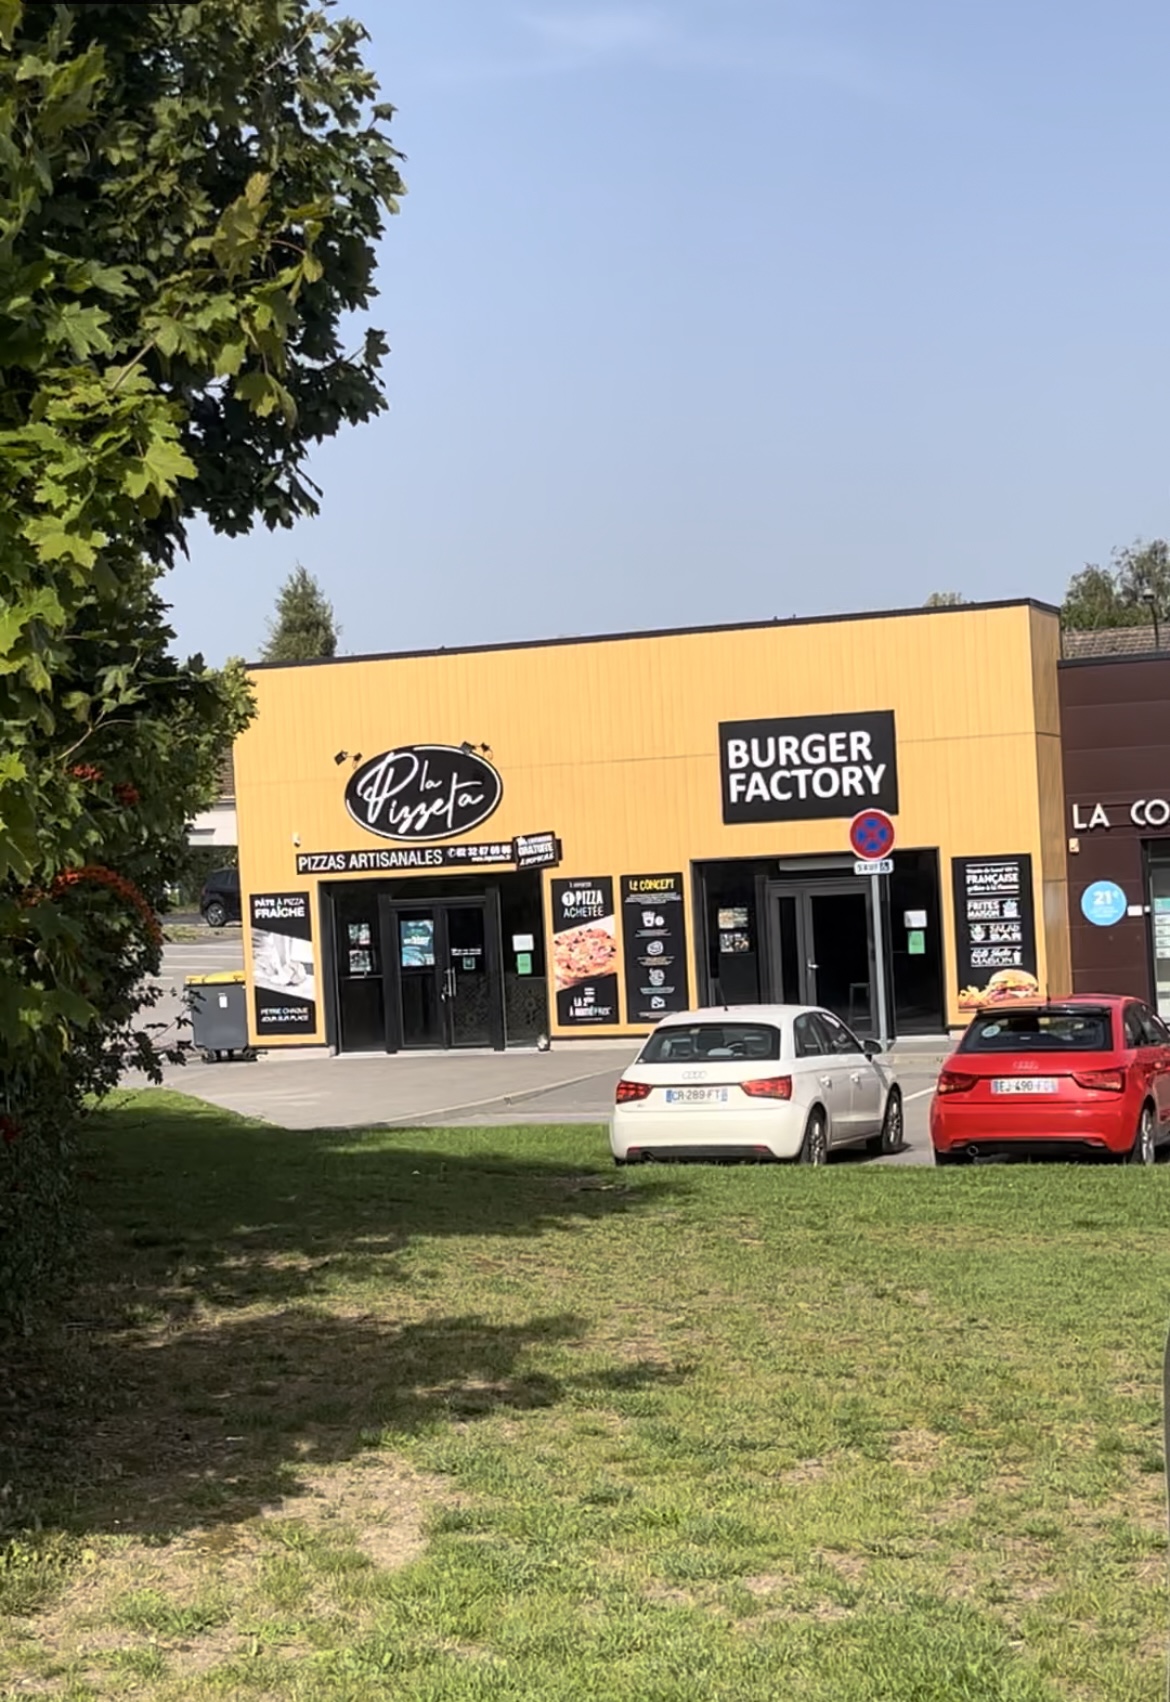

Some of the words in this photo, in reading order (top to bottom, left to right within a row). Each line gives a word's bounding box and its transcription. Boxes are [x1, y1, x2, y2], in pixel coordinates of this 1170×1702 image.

[727, 731, 872, 769] BURGER
[420, 760, 442, 792] la
[729, 764, 886, 803] FACTORY
[356, 751, 485, 834] Pizzeta
[1072, 803, 1110, 829] LA
[298, 853, 346, 871] PIZZAS
[349, 849, 443, 869] ARTISANALES
[639, 878, 675, 891] CONCEPT
[966, 873, 1019, 885] FRANÇAISE
[575, 890, 604, 906] PIZZA
[254, 906, 305, 919] FRAÎCHE
[563, 905, 605, 918] ACHETÉE
